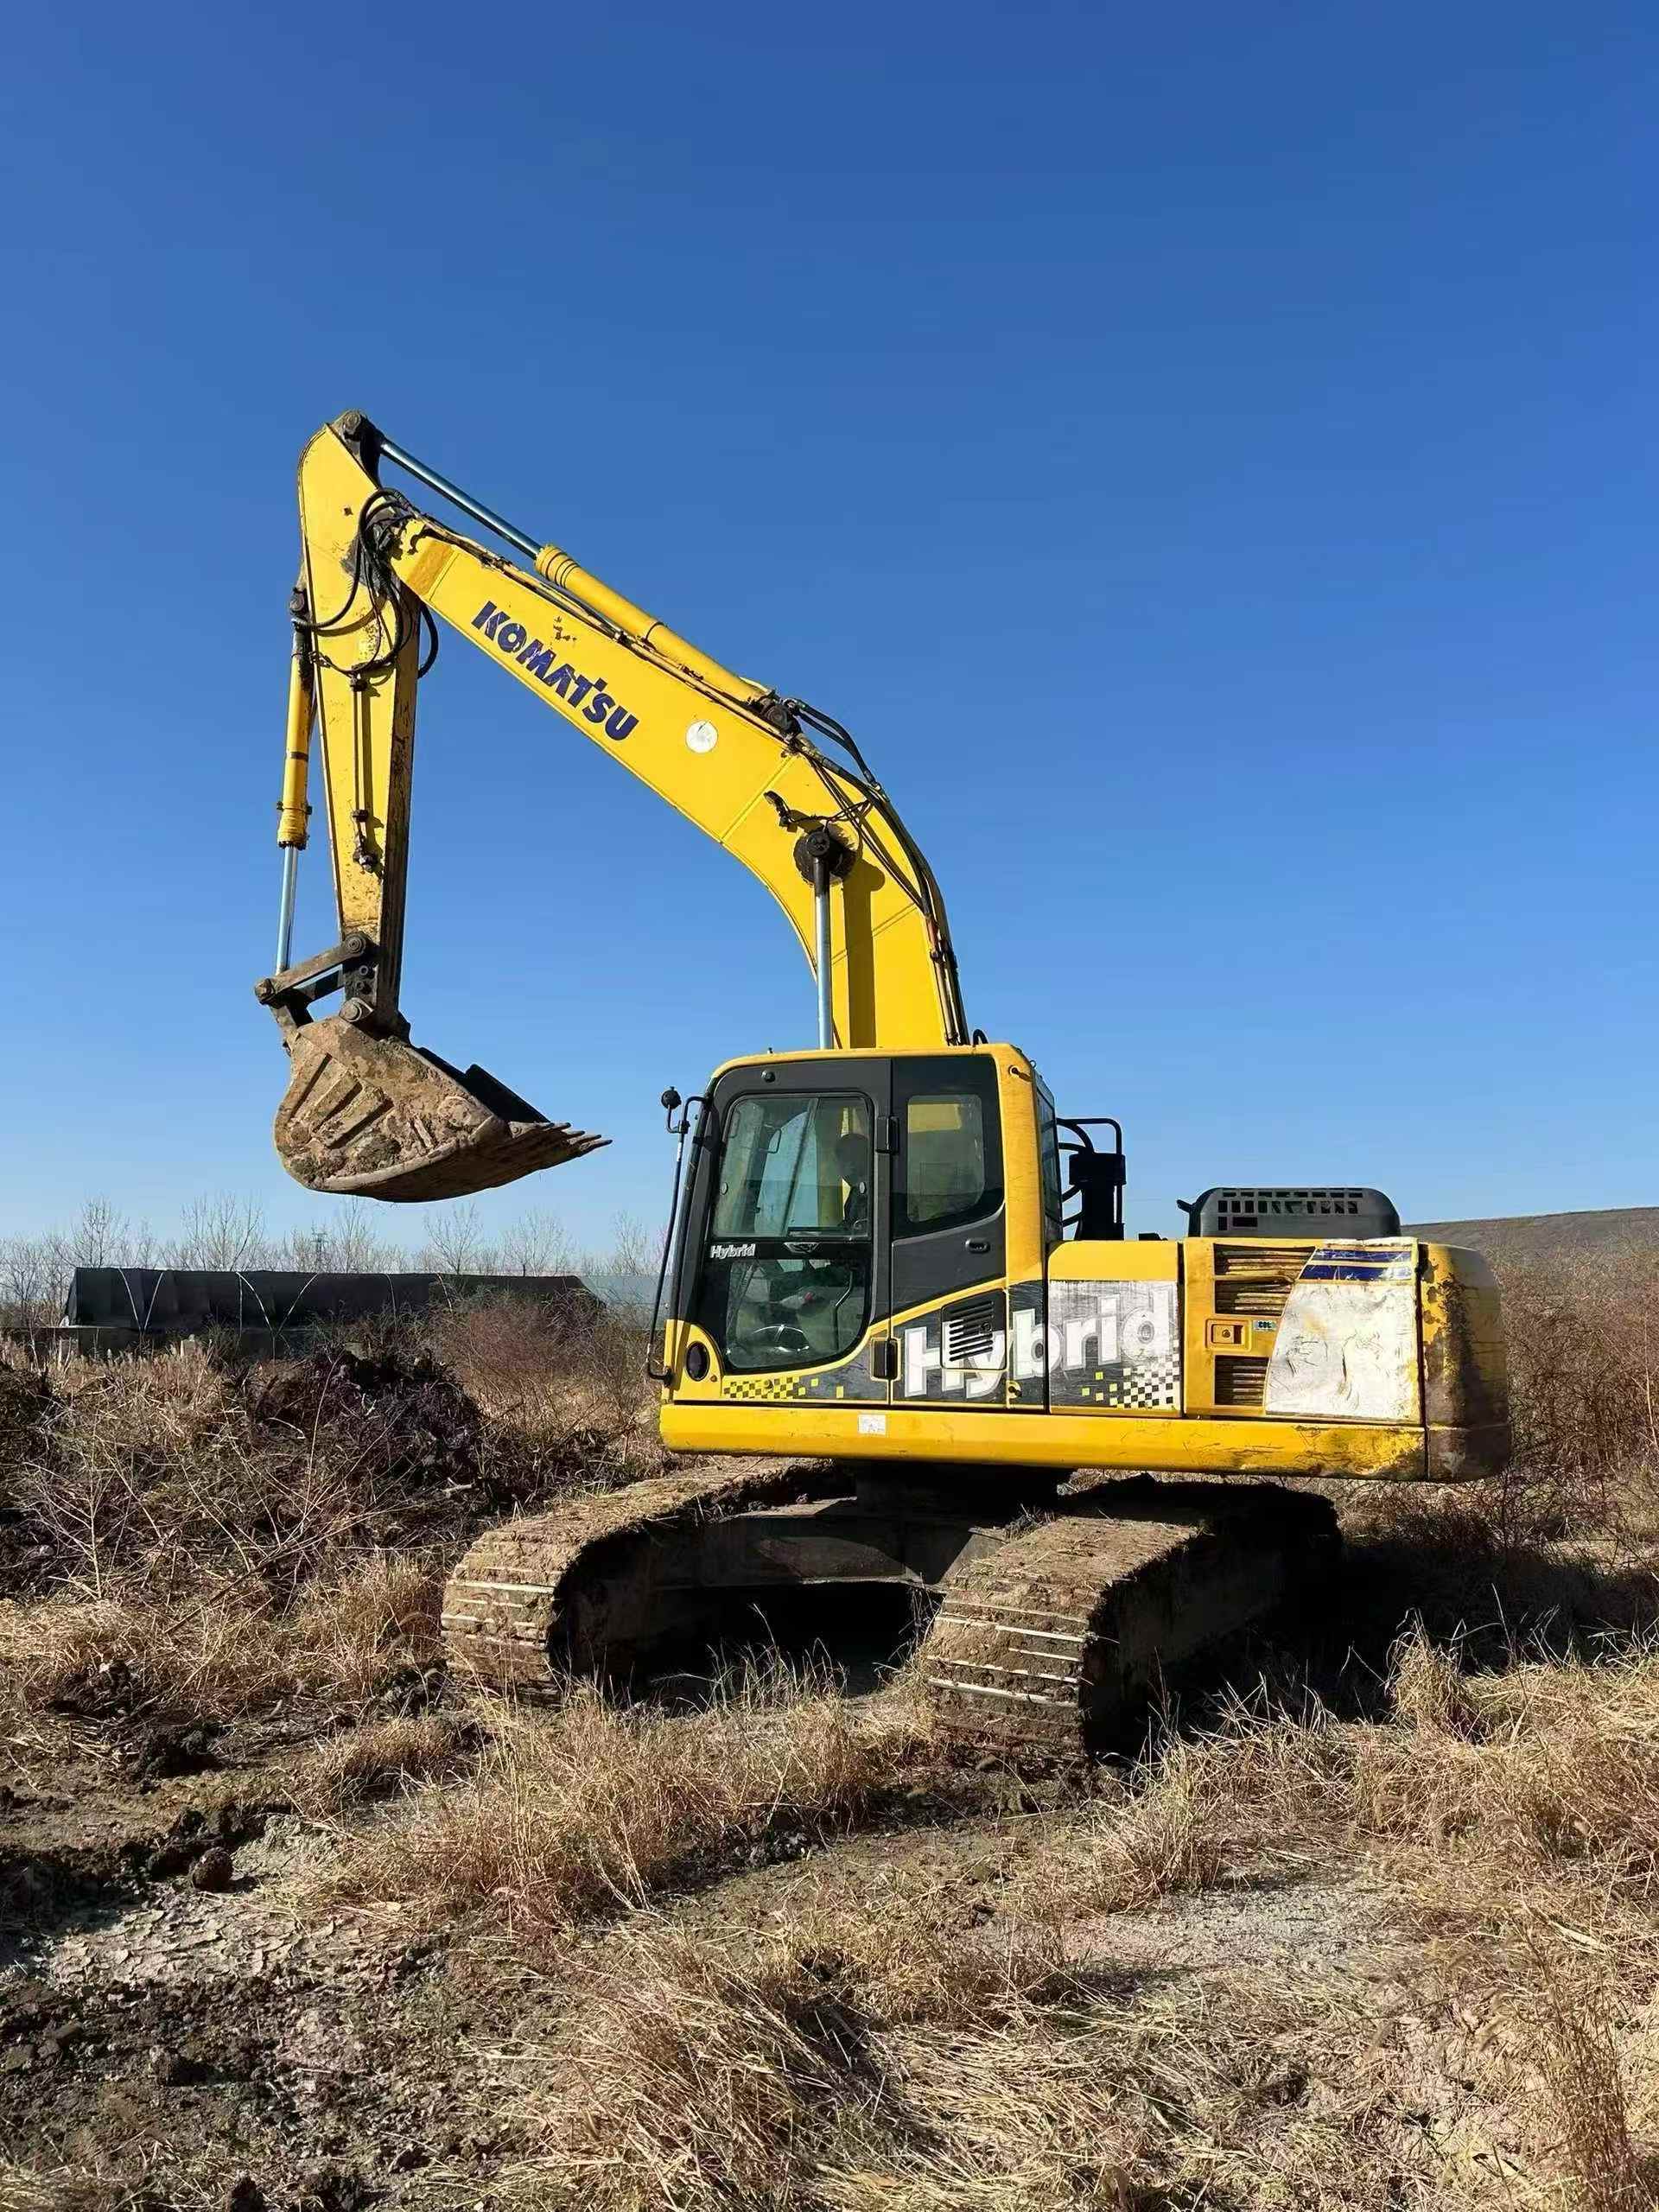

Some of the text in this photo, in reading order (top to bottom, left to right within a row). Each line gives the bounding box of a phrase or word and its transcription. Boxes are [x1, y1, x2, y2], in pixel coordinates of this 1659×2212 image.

[471, 601, 639, 741] KOMATSU
[710, 1243, 756, 1259] Hybrid
[905, 1284, 1173, 1398] Hybrid
